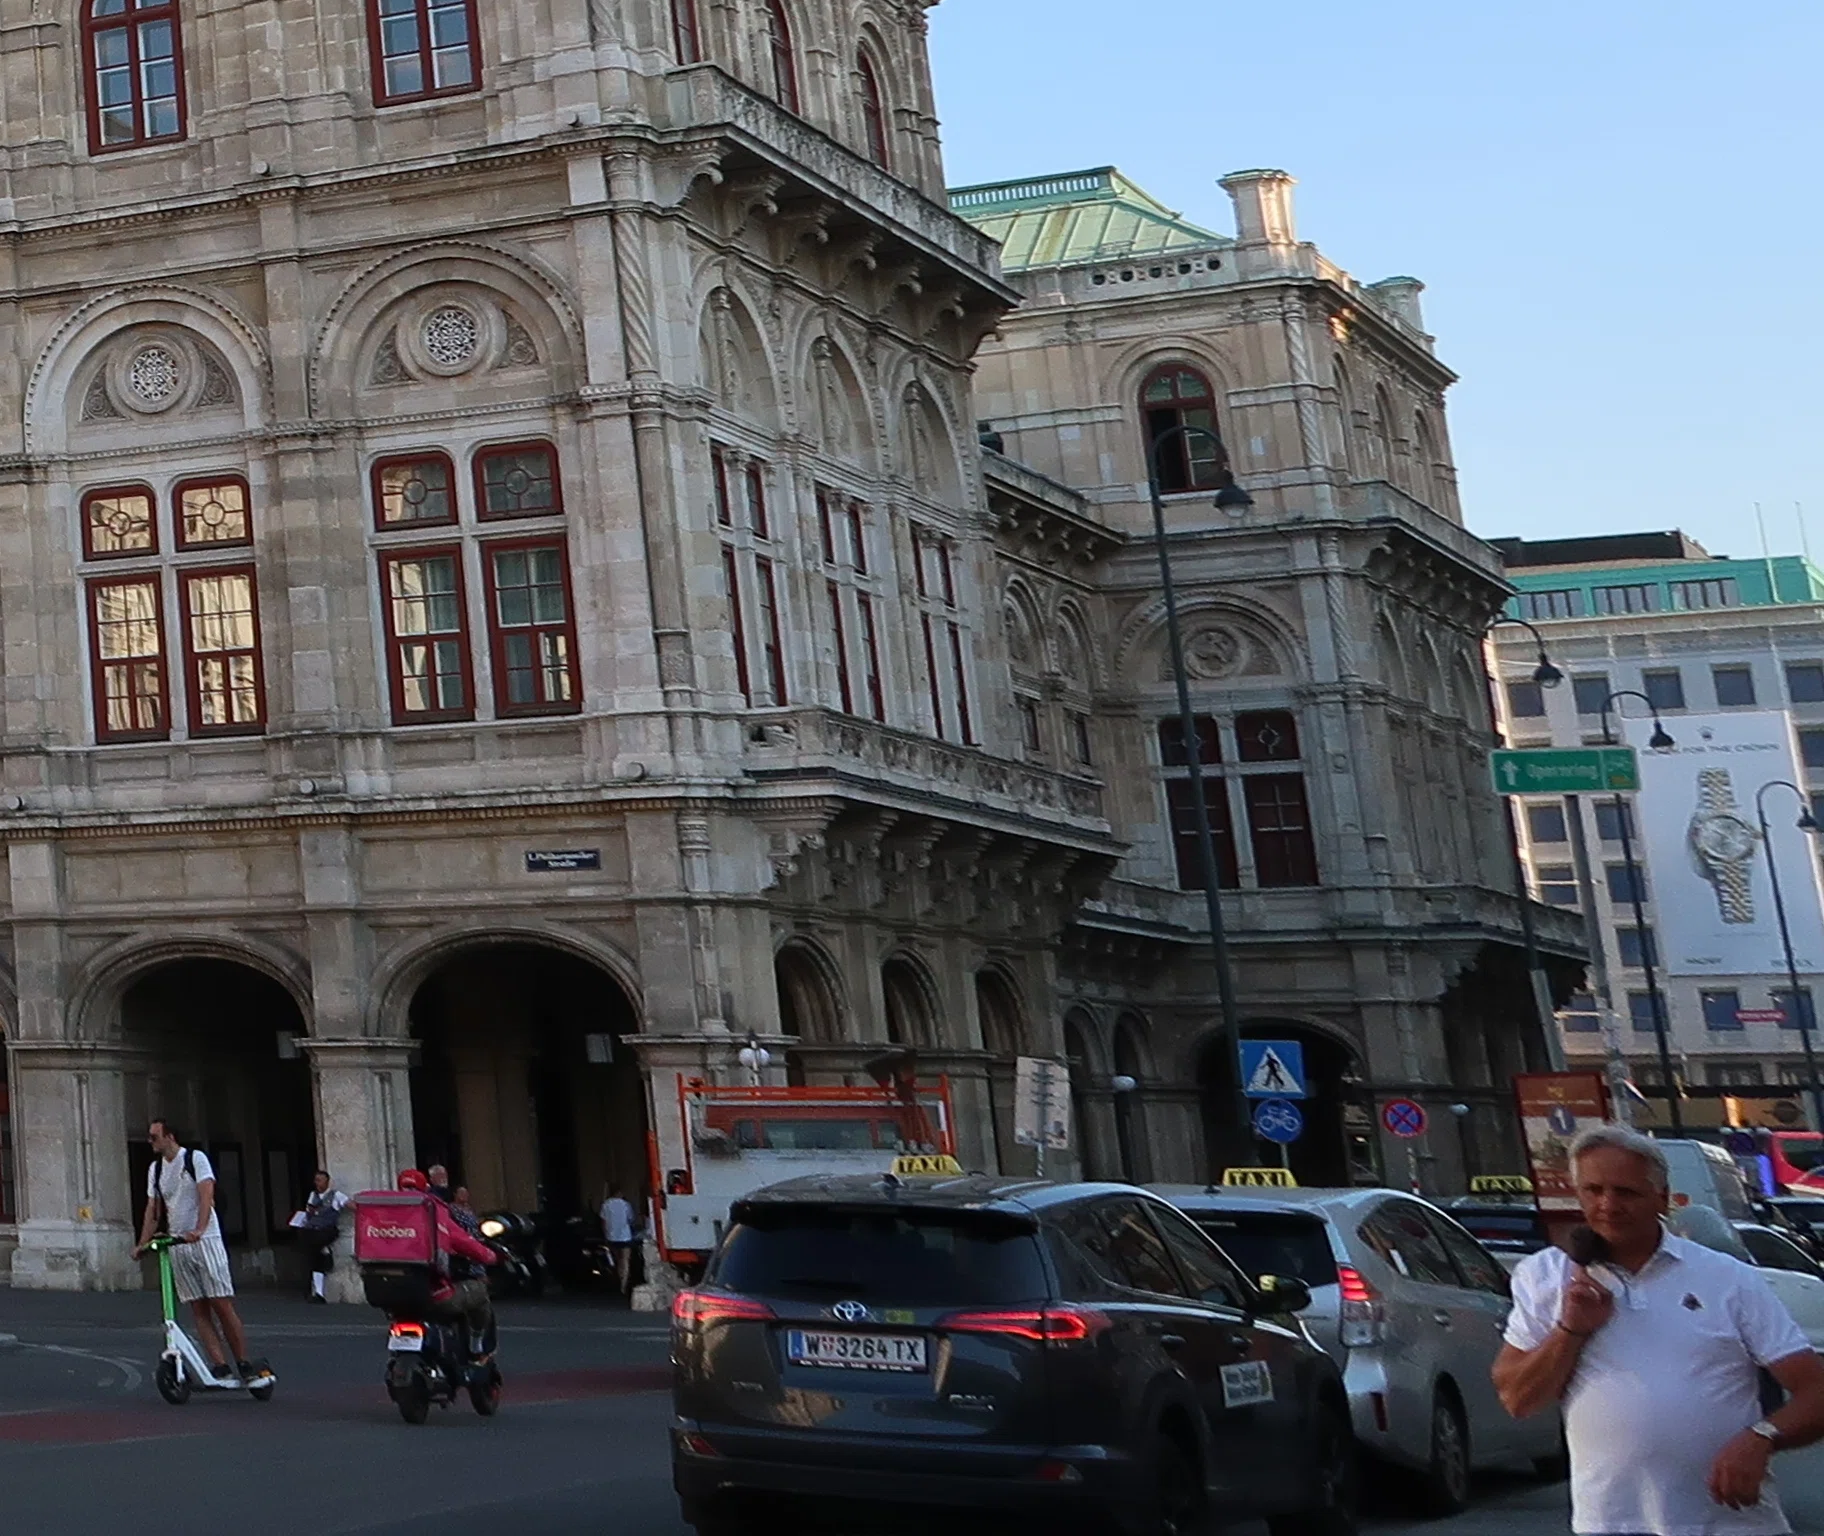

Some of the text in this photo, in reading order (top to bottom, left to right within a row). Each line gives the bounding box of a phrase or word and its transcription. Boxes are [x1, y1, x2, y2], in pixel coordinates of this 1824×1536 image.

[898, 1157, 947, 1174] TAXI
[1232, 1172, 1285, 1187] TAXI
[367, 1225, 417, 1238] foodora
[805, 1334, 920, 1361] W 3264 TX
